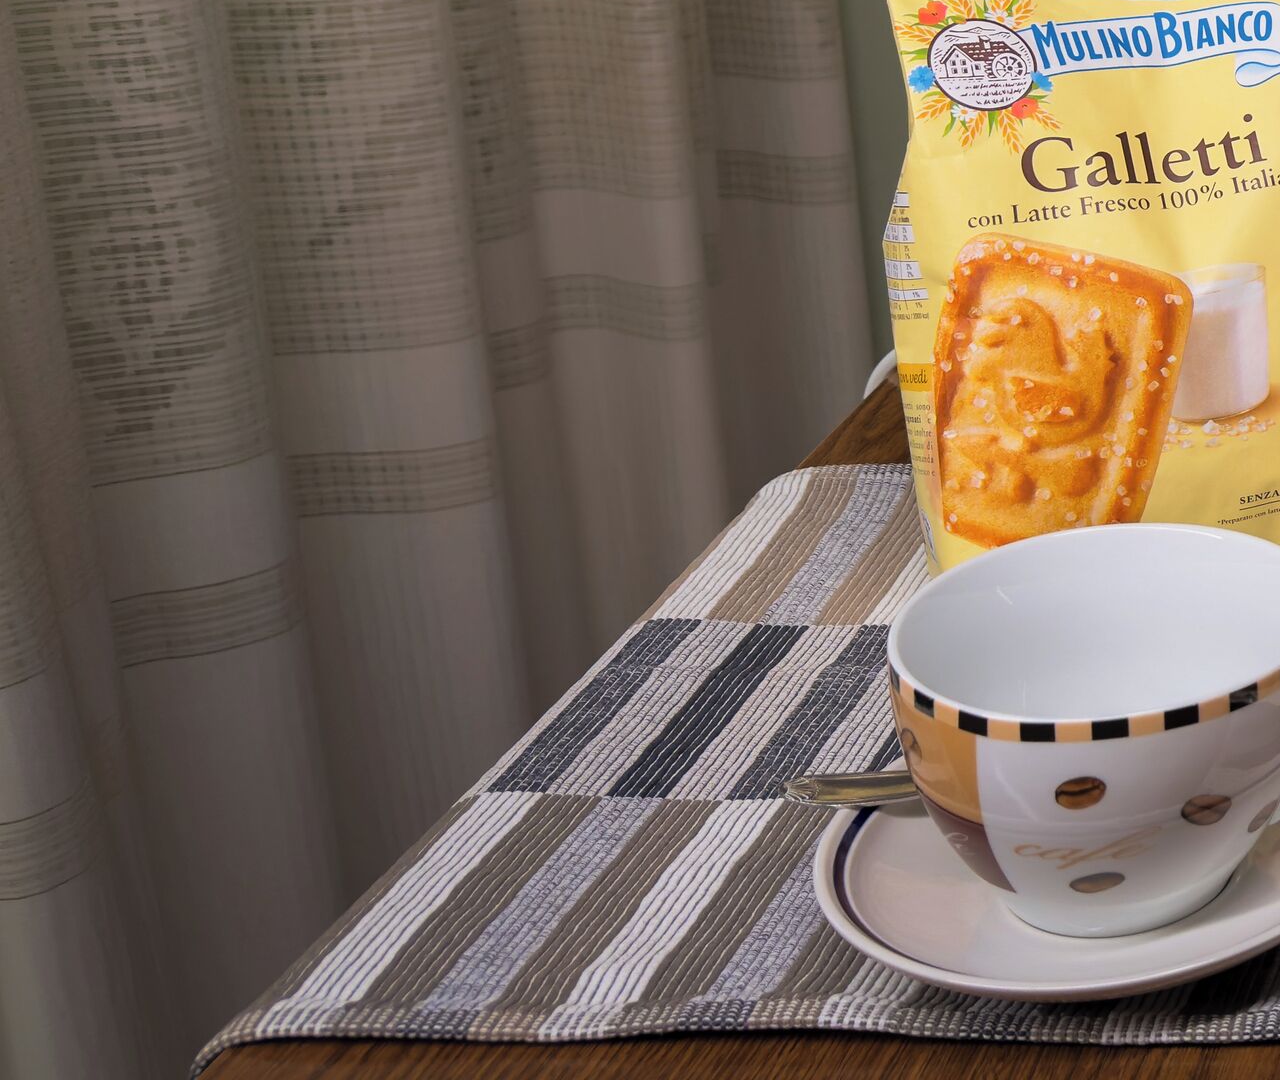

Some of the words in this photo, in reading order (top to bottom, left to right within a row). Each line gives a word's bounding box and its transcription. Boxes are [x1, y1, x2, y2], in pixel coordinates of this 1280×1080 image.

[1034, 23, 1153, 69] MULINO
[1153, 10, 1273, 59] BIANCO
[1020, 113, 1268, 193] Galletti
[967, 213, 1003, 228] con
[1011, 204, 1071, 224] Latte
[1080, 196, 1151, 216] Fresco
[1158, 182, 1224, 210] 100%
[1240, 489, 1280, 505] SENZA
